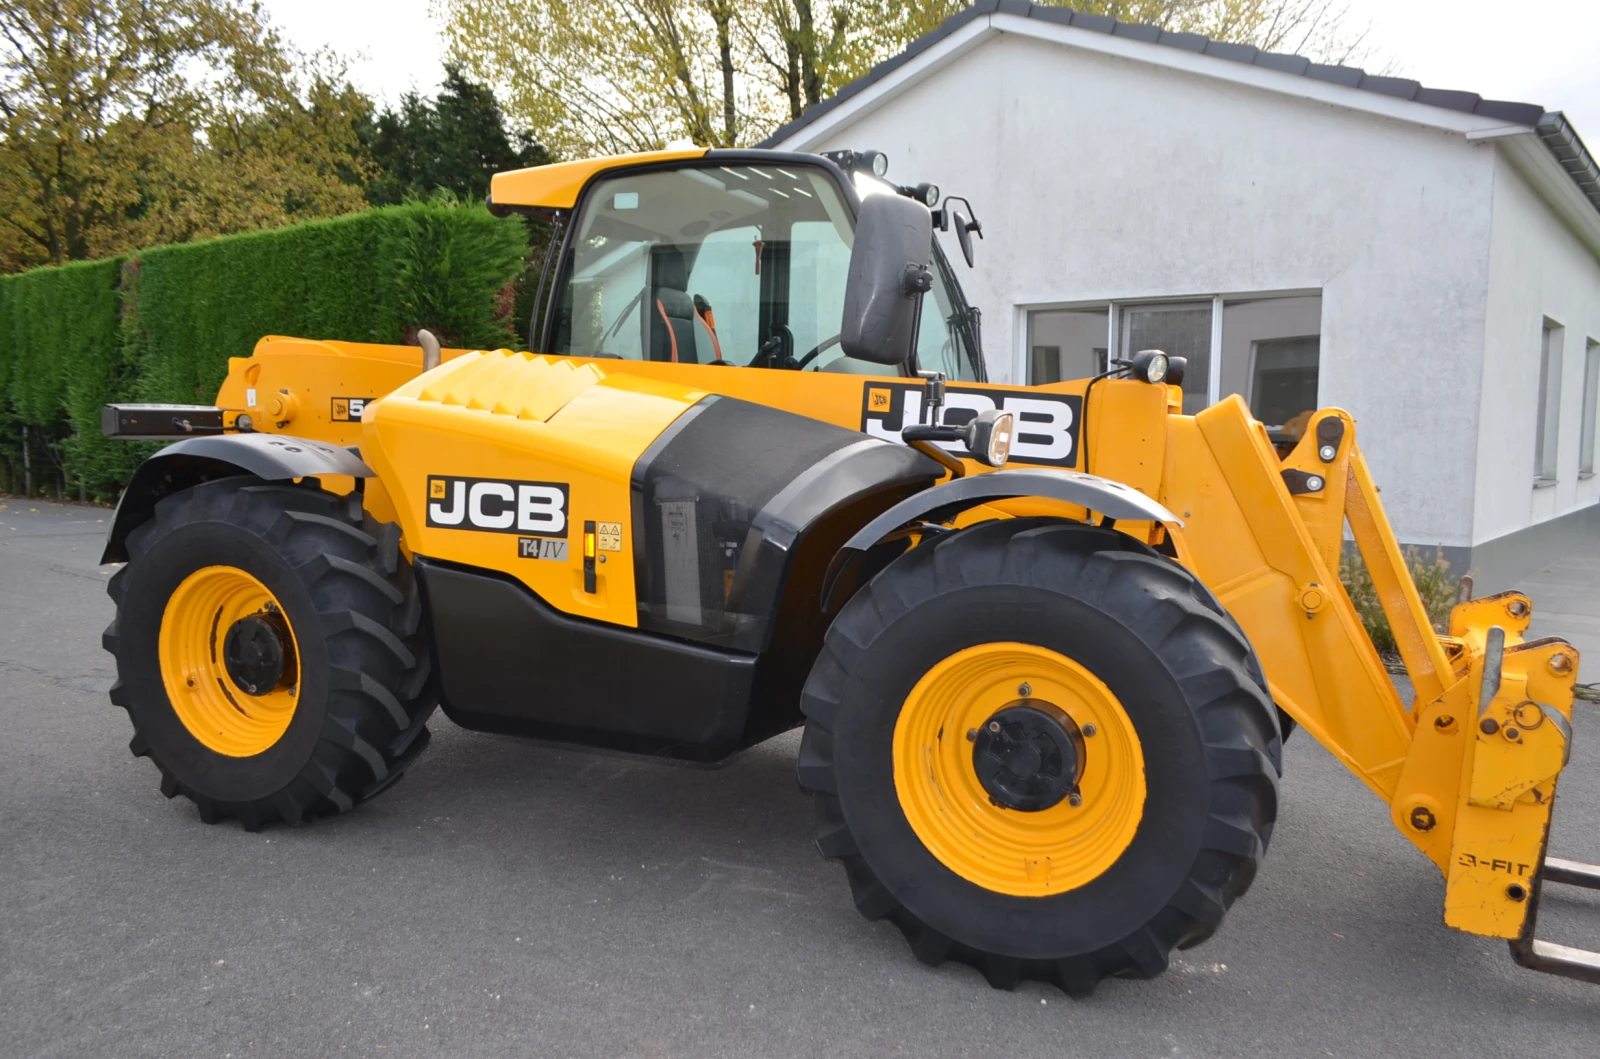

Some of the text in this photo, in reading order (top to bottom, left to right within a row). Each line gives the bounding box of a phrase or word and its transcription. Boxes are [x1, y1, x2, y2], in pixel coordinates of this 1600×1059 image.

[429, 480, 566, 533] JCB
[520, 539, 565, 559] T4 IV
